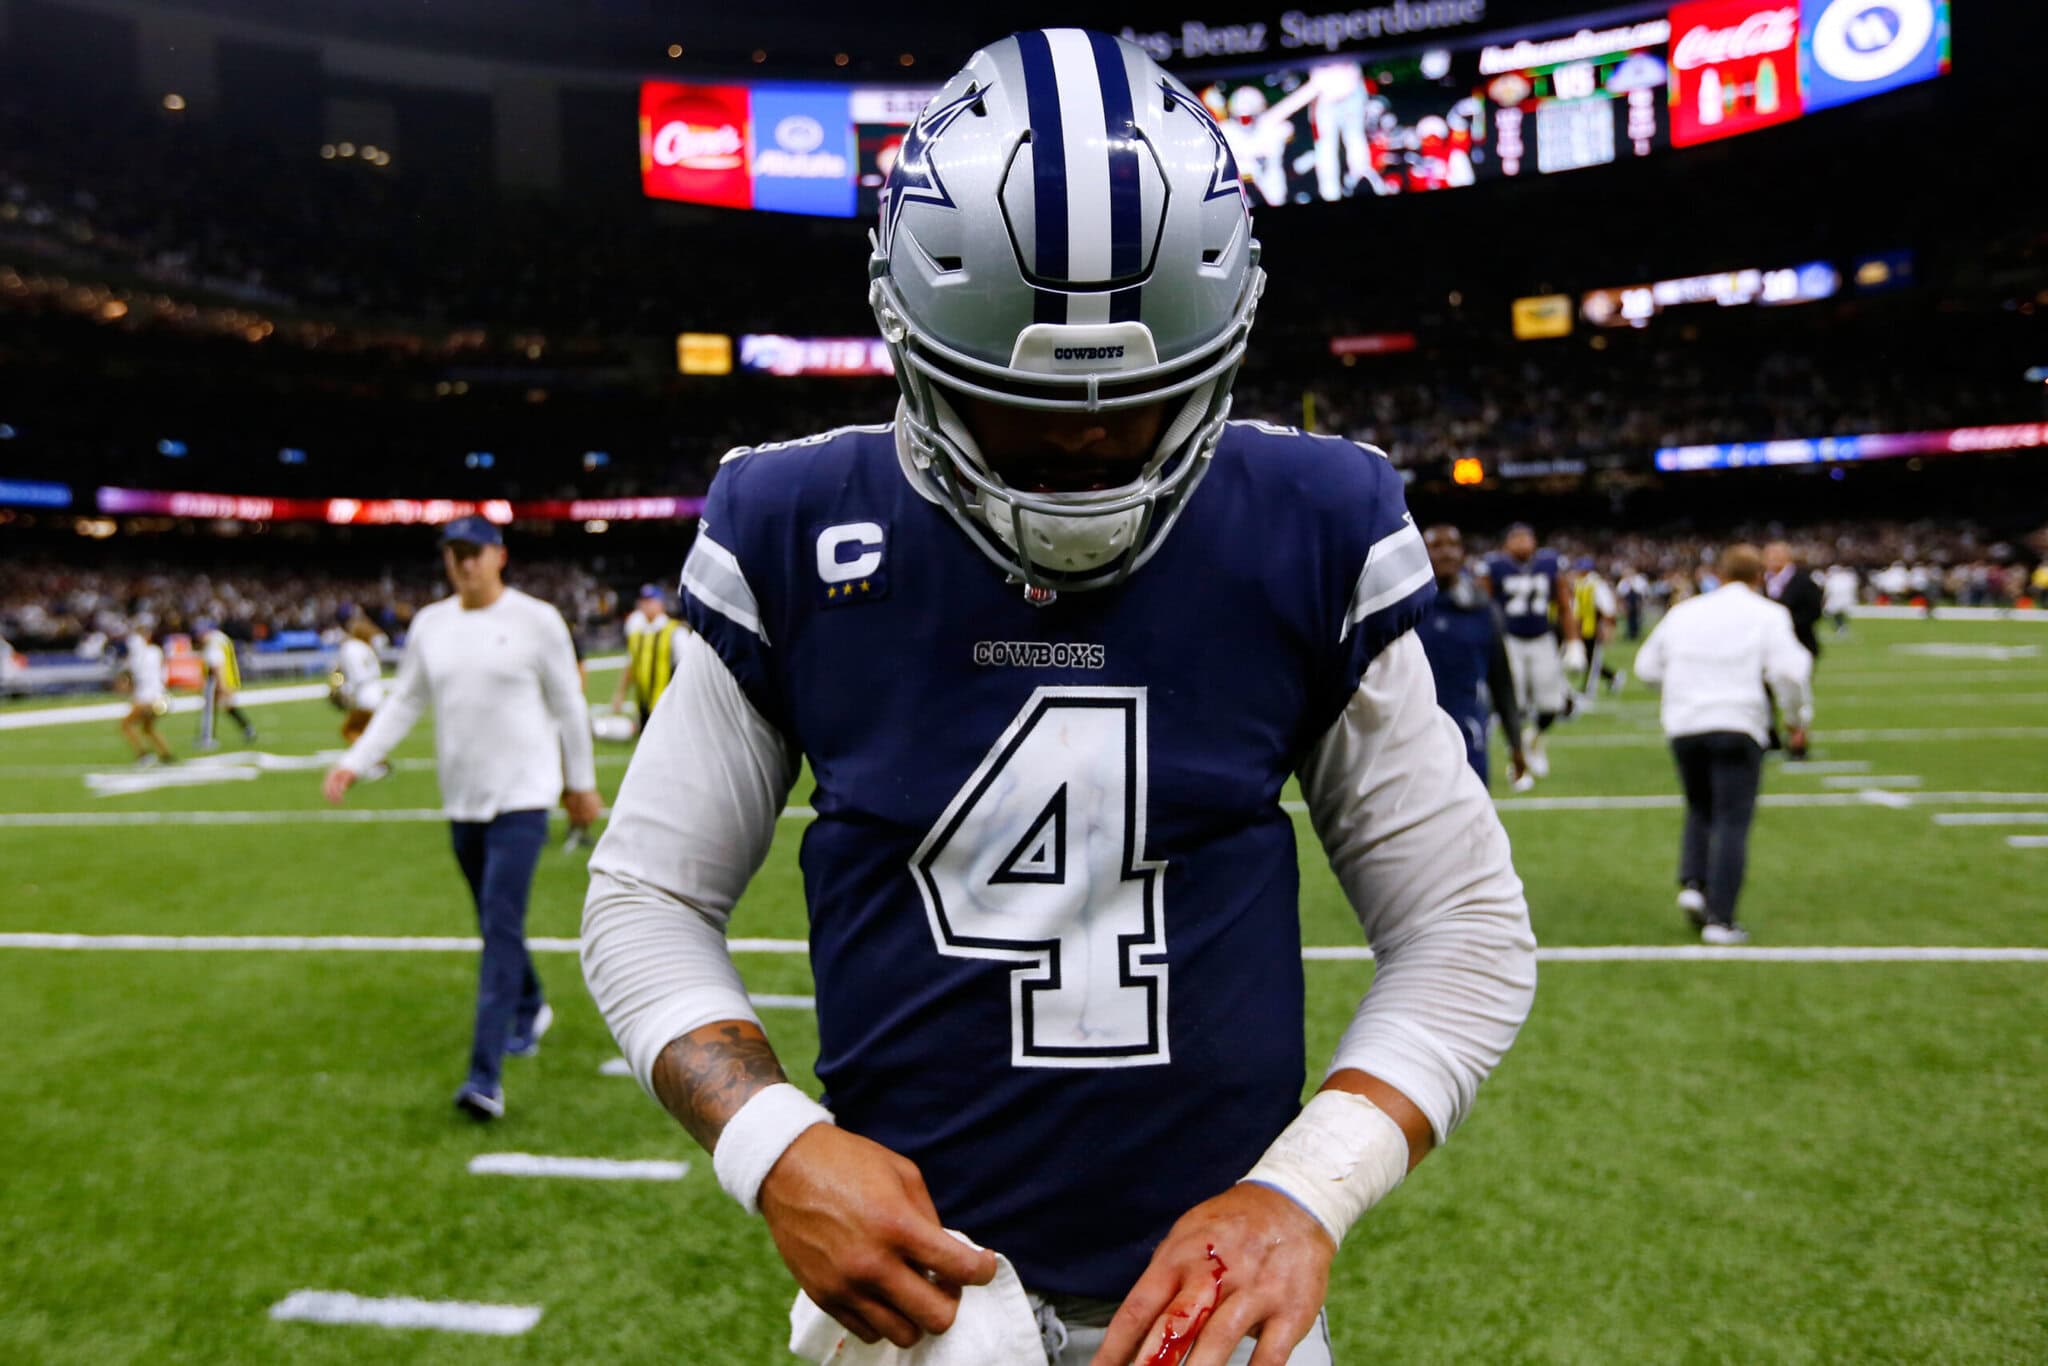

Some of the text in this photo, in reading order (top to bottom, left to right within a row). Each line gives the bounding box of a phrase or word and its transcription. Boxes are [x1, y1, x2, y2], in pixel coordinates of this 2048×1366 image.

[1281, 0, 1486, 50] Superdome
[1054, 346, 1124, 360] COWBOYS
[816, 522, 883, 583] C
[974, 641, 1104, 669] COWBOYS
[908, 686, 1170, 1067] 4
